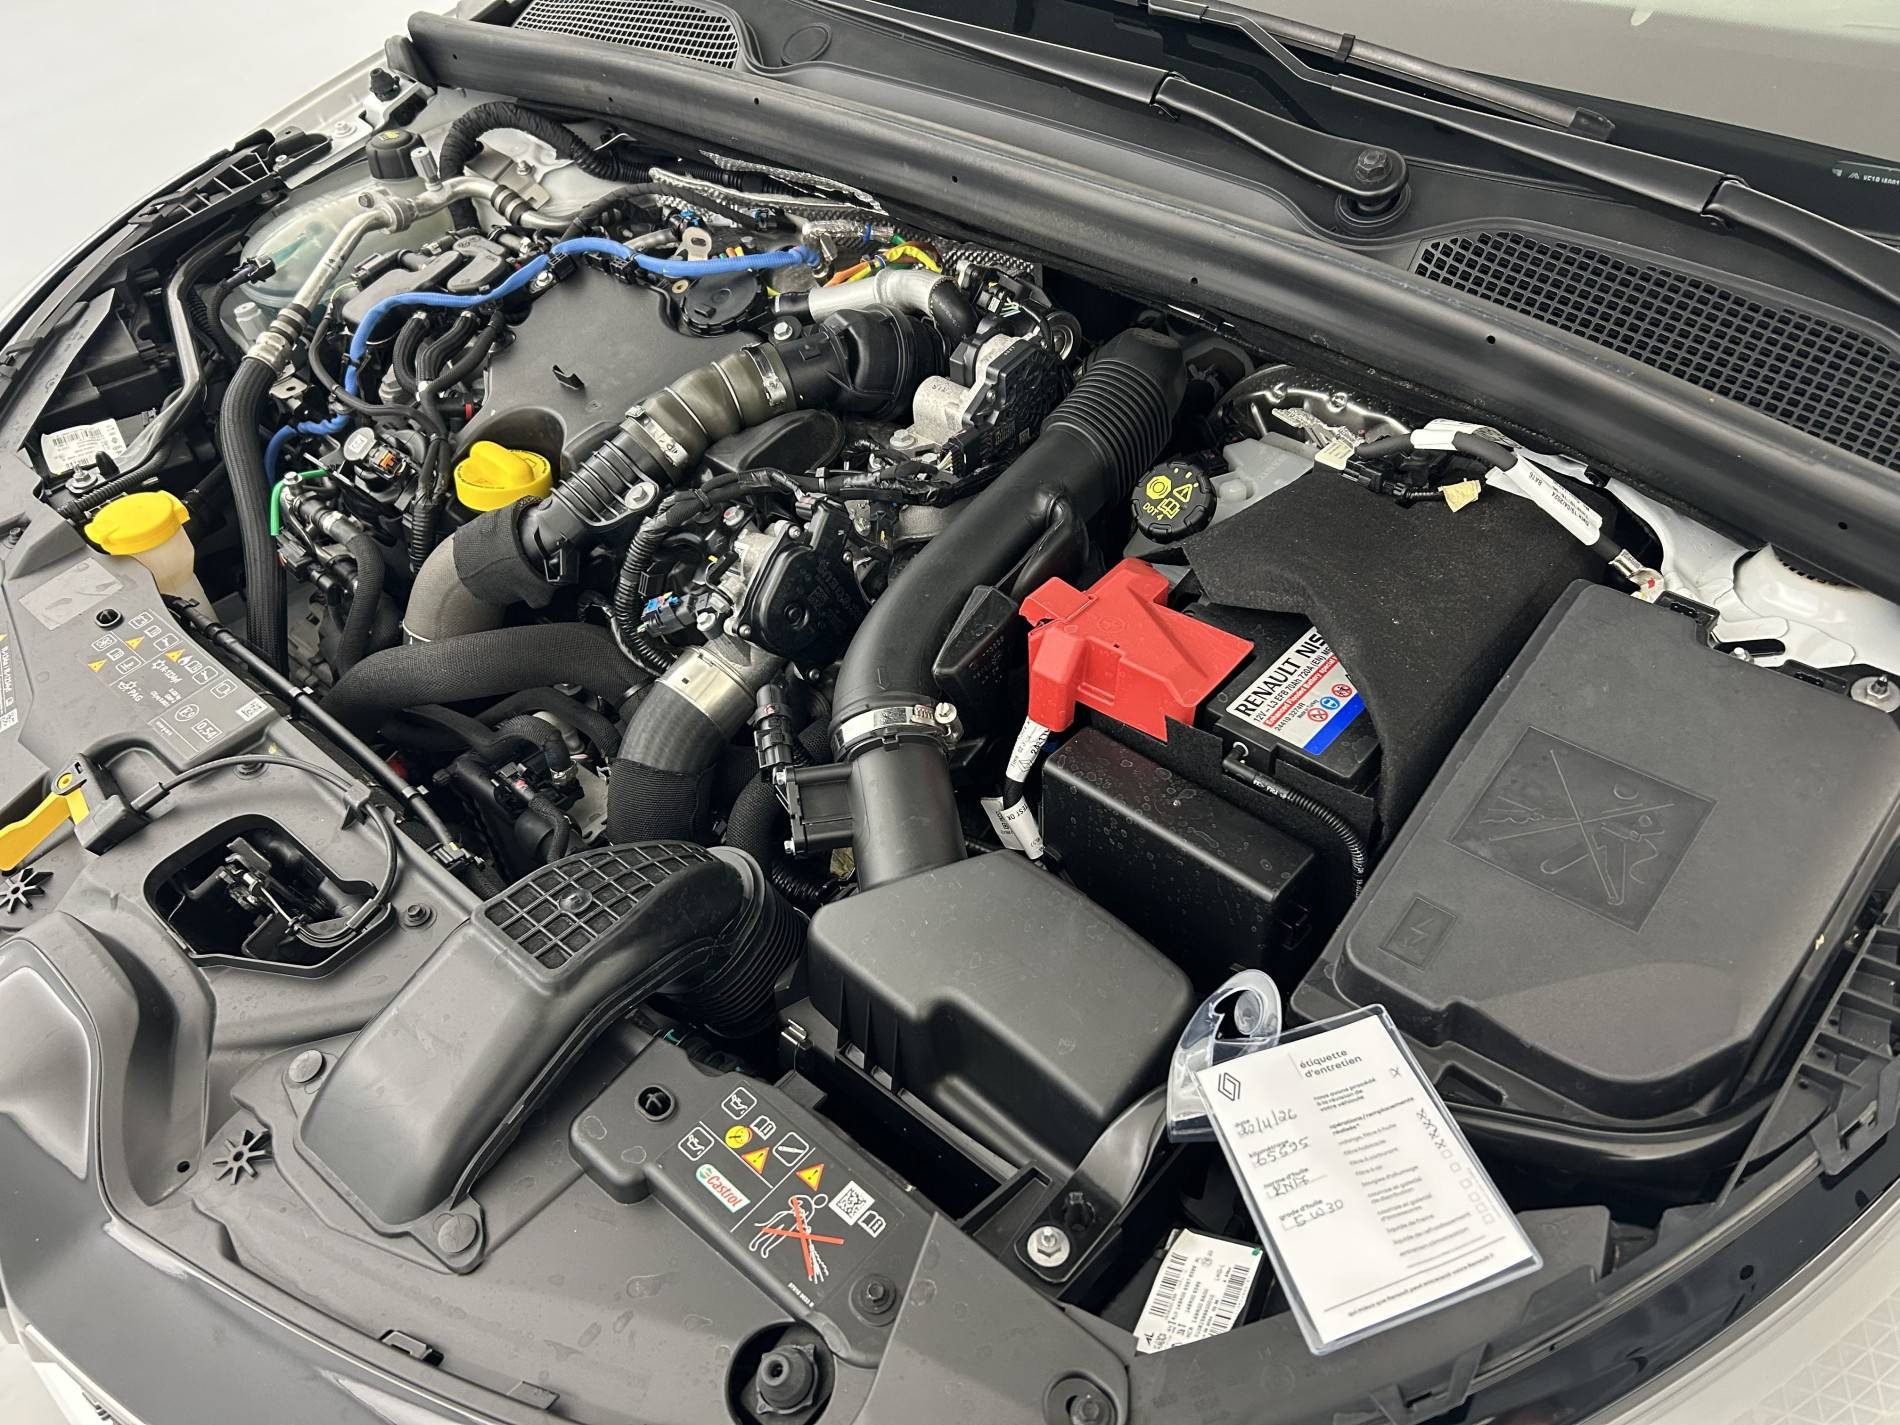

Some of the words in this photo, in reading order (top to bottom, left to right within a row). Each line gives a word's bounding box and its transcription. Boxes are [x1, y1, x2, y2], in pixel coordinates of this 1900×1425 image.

[1142, 502, 1158, 516] DOT
[1234, 657, 1301, 717] RENAULT
[1295, 630, 1325, 658] NIS
[128, 687, 144, 703] PAG
[1253, 711, 1266, 722] 12V
[1268, 699, 1278, 708] L3
[1275, 689, 1289, 702] EFB
[1286, 676, 1301, 691] 70Ah
[1299, 664, 1314, 678] 720A
[1310, 654, 1326, 667] (EN)
[1300, 1050, 1347, 1069] étiquette
[1305, 1056, 1362, 1078] d'entretien
[707, 1175, 743, 1206] Castrol
